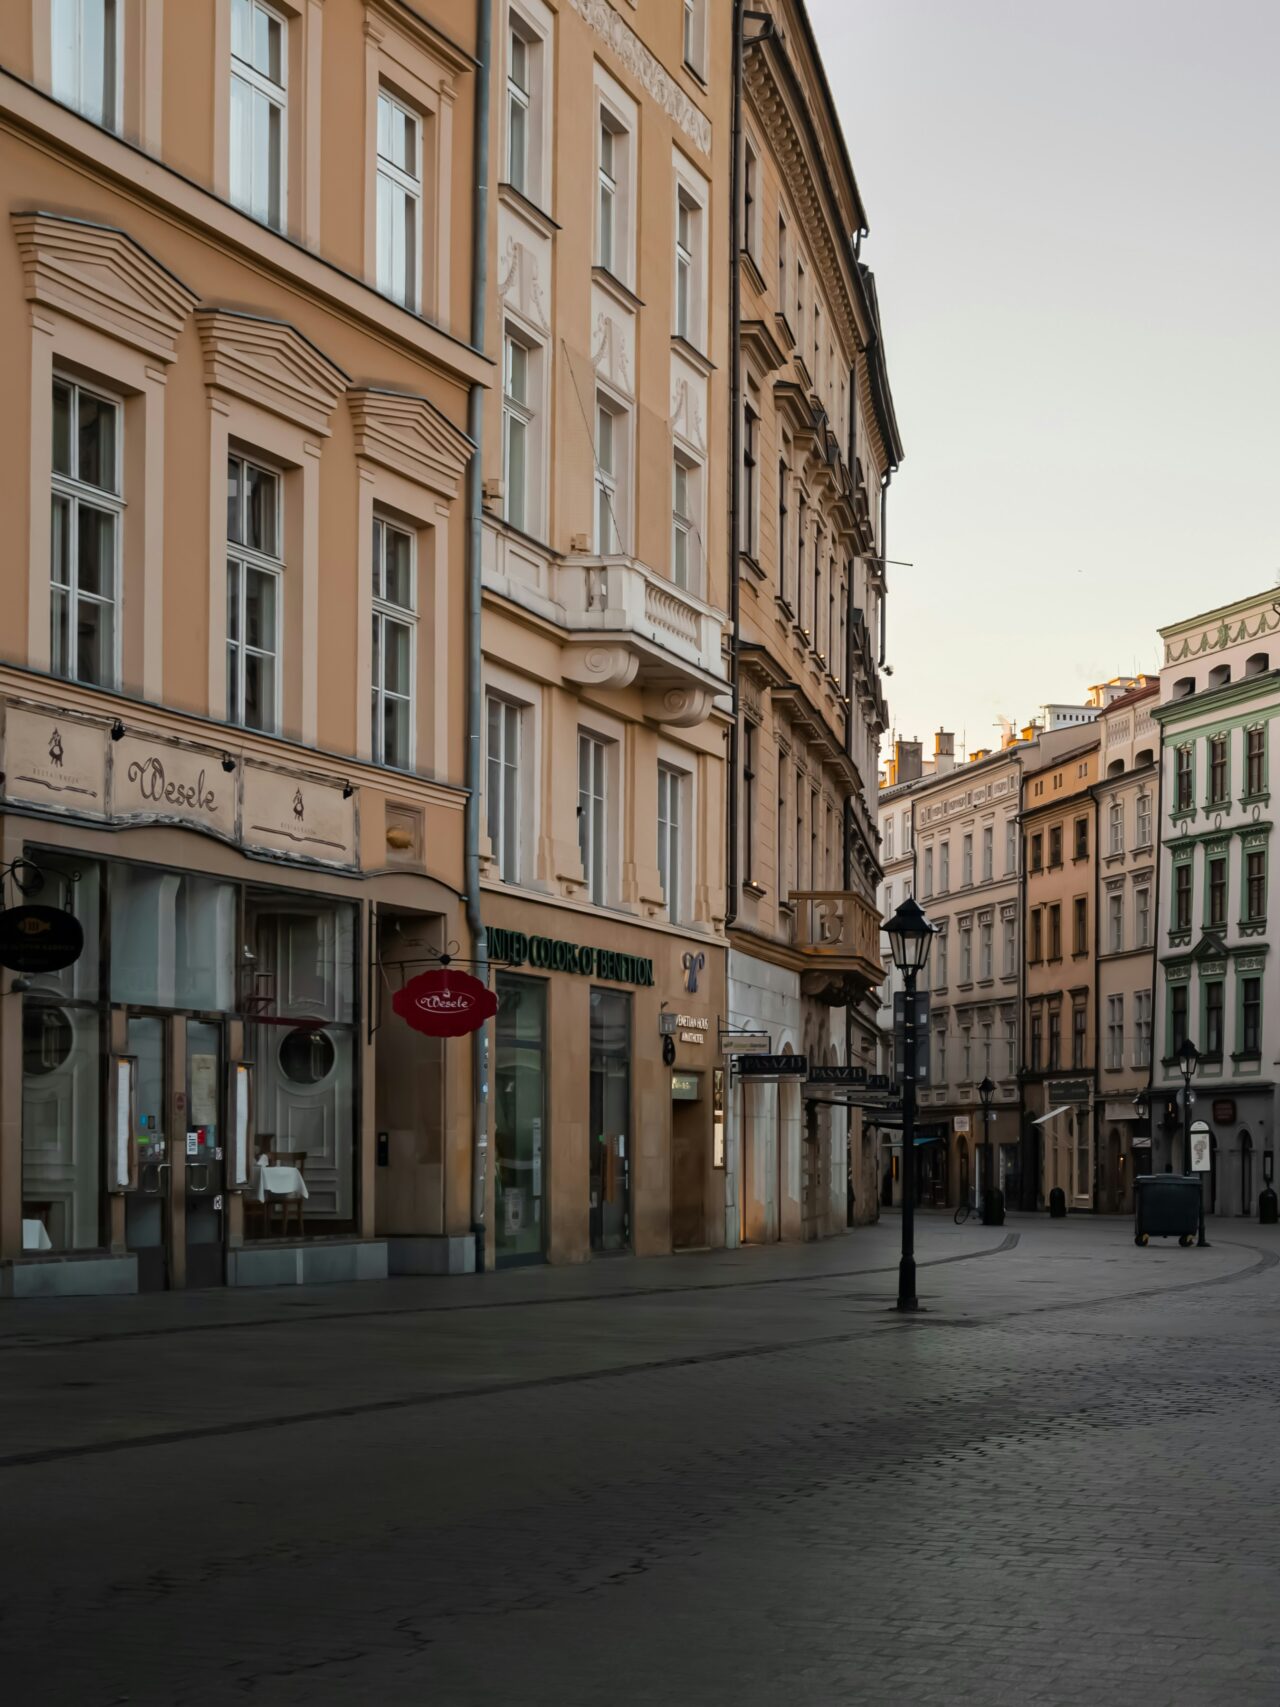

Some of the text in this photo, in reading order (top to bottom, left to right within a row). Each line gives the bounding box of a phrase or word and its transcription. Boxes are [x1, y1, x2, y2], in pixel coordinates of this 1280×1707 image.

[128, 757, 218, 812] Wesele
[486, 926, 528, 962] UNITED
[527, 935, 579, 973] COLORS
[577, 945, 597, 975] OF
[420, 995, 469, 1008] Wesele
